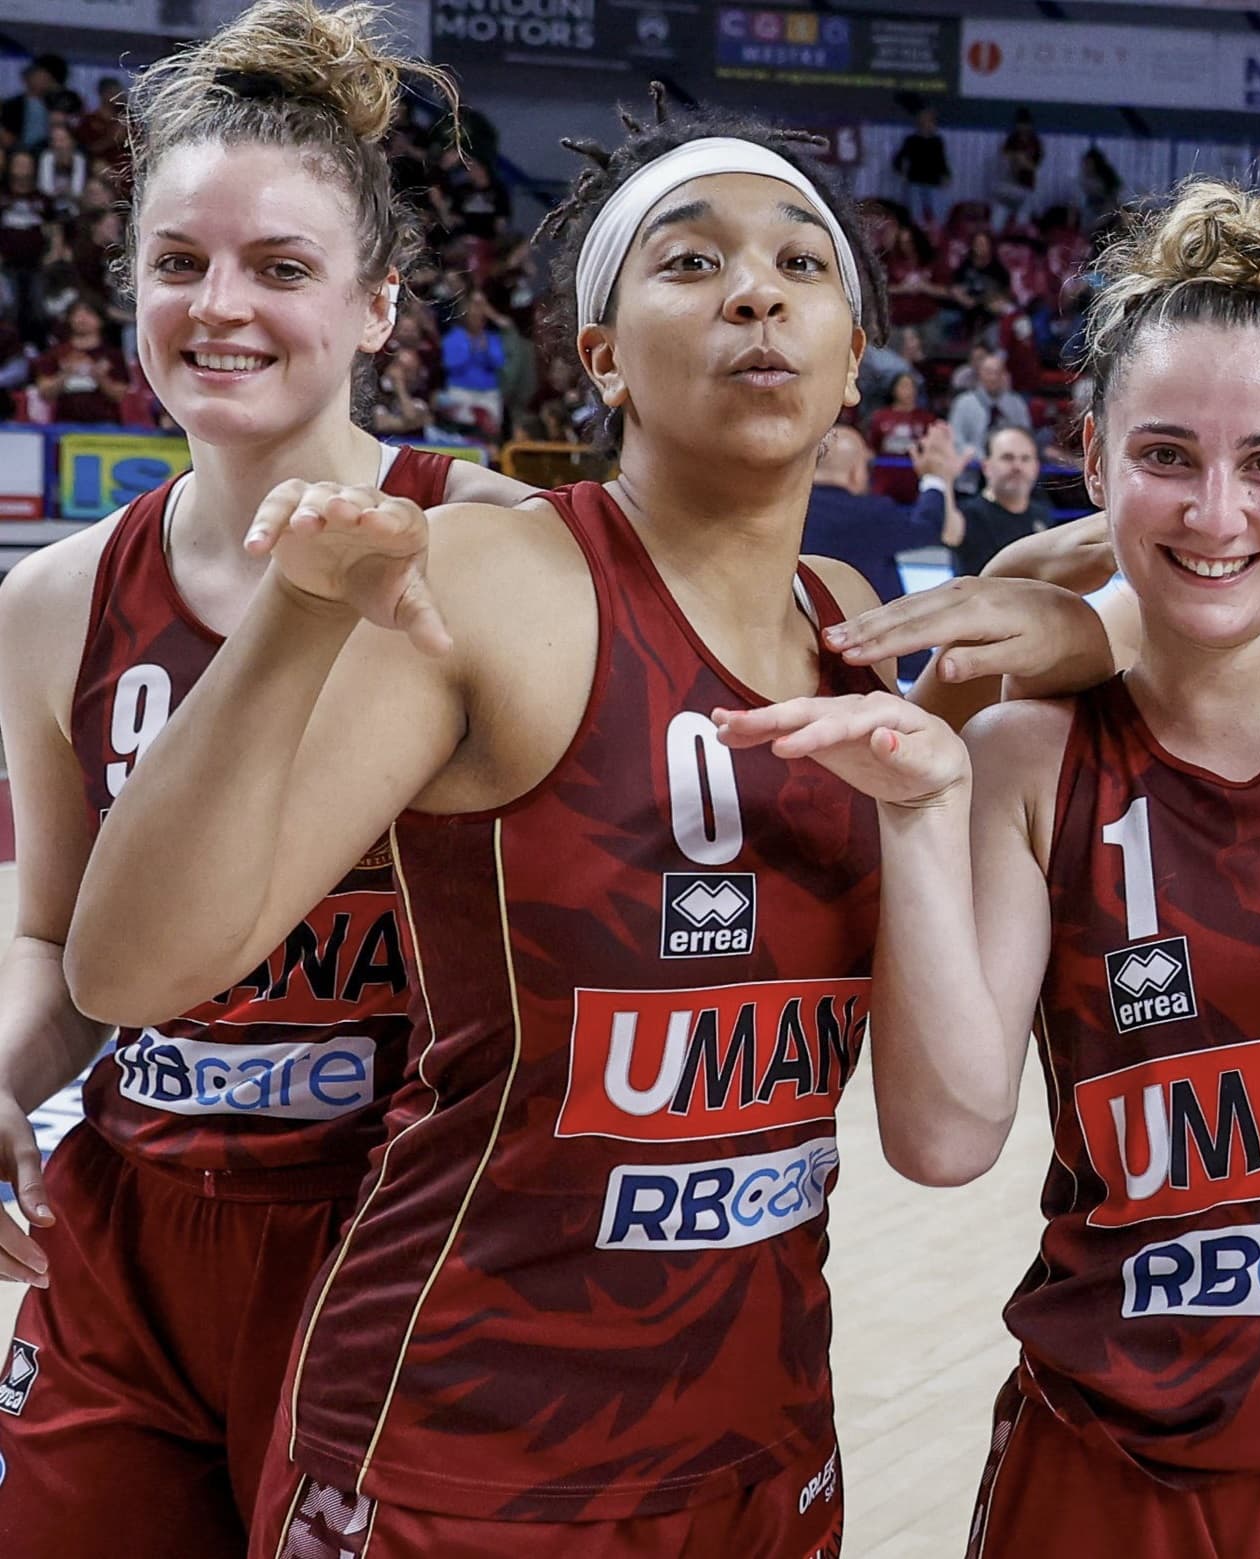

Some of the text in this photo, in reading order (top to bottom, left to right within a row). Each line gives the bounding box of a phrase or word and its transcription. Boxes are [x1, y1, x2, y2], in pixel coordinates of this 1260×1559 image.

[435, 13, 595, 49] MOTORS
[105, 663, 172, 799] 9
[667, 710, 744, 866] 0
[1102, 796, 1159, 941] 1
